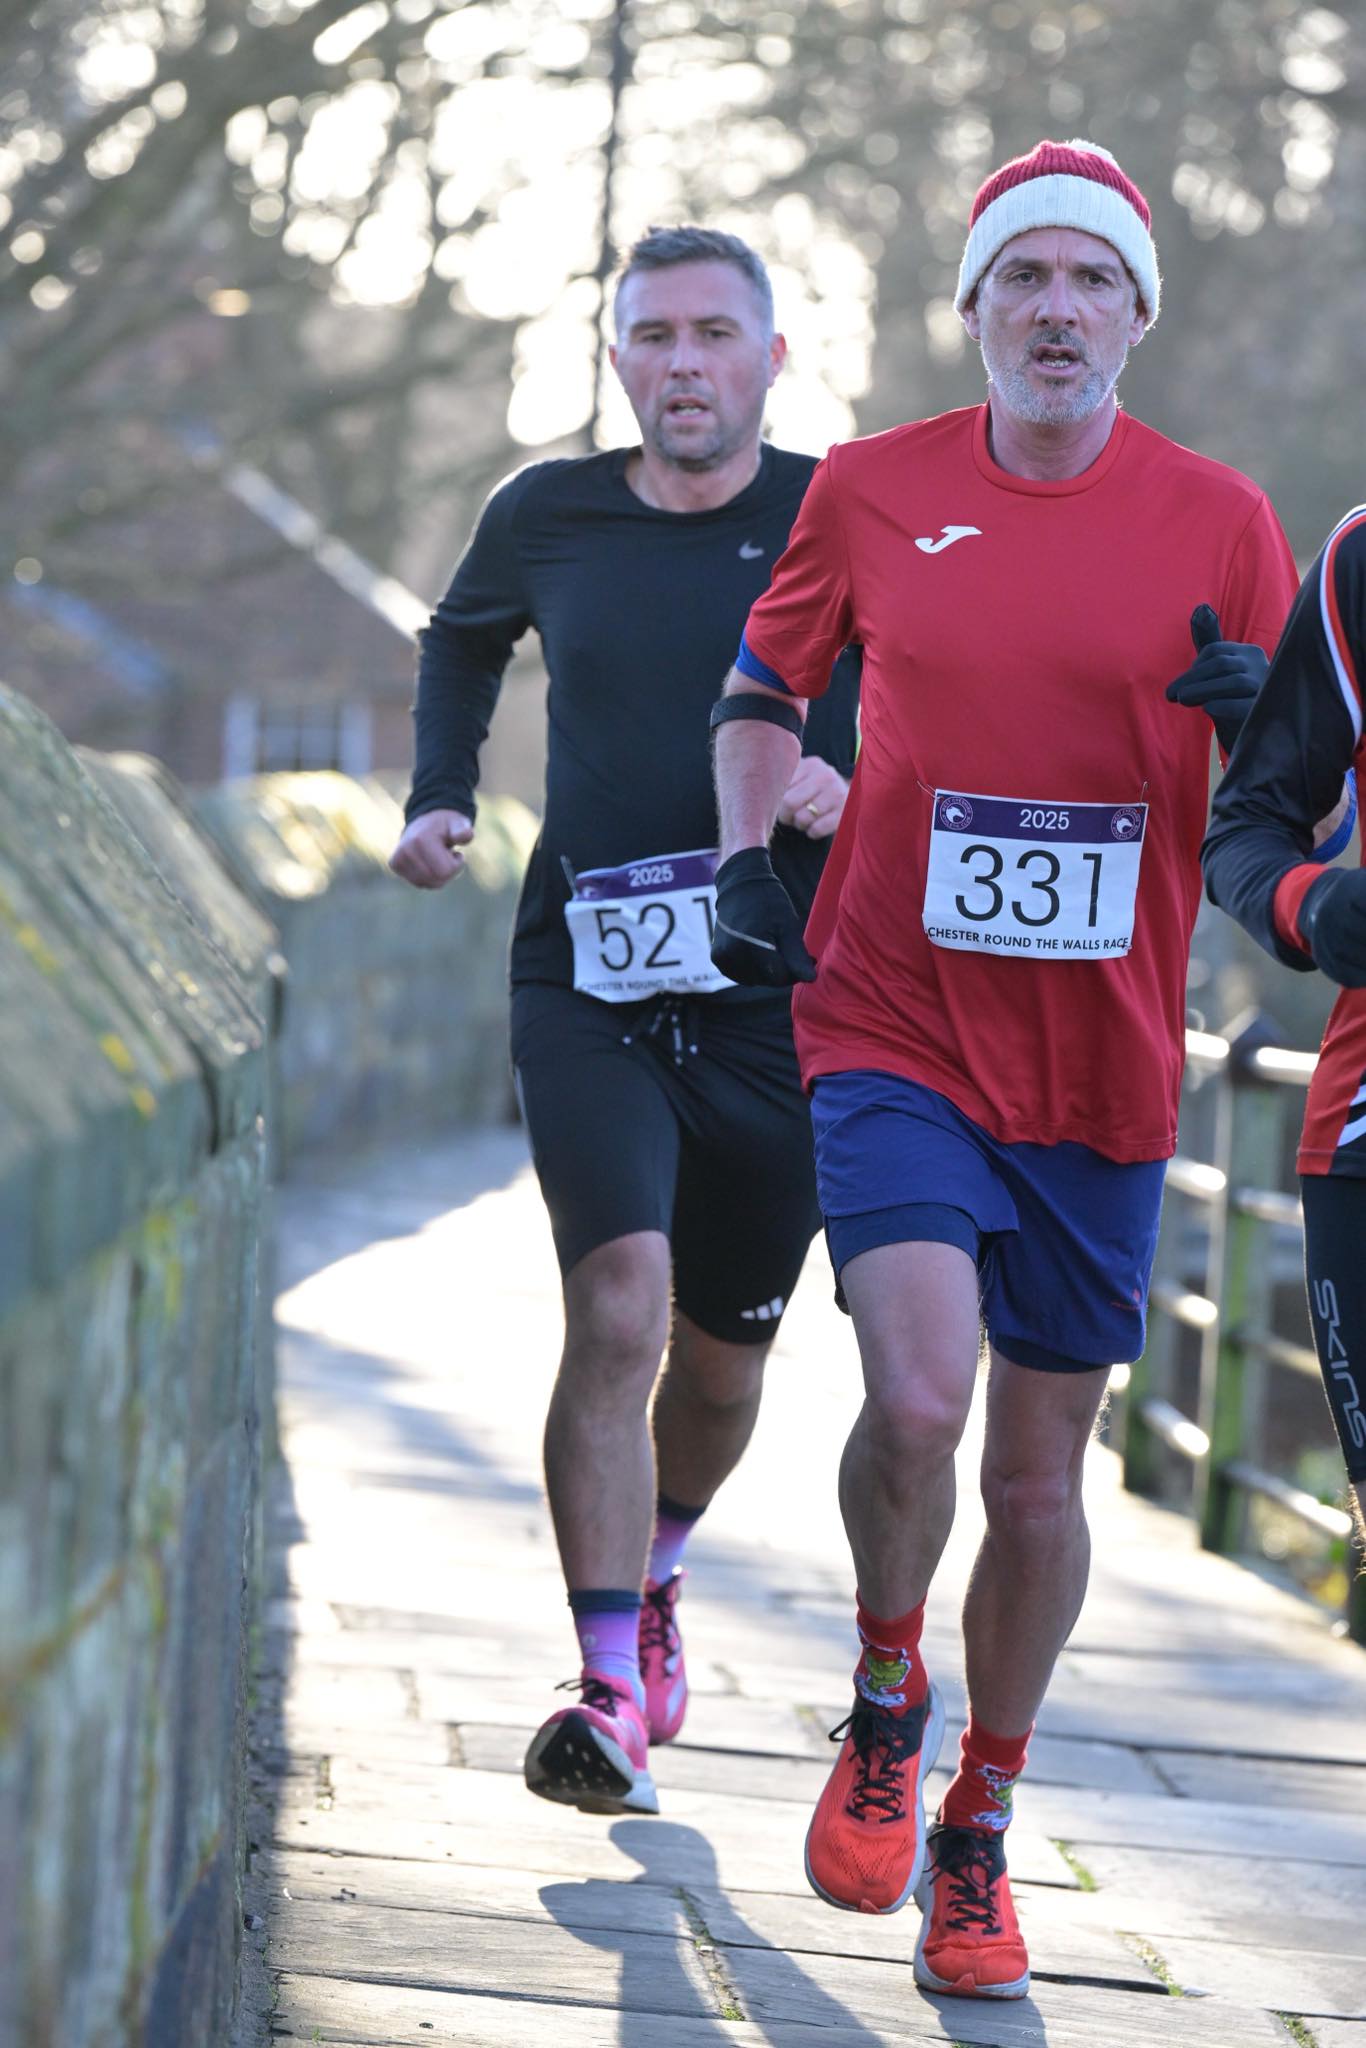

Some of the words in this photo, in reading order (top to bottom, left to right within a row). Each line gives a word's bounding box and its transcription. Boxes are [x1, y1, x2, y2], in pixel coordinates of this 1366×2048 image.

[1019, 808, 1070, 831] 2025
[628, 864, 674, 888] 2025
[955, 844, 1103, 928] 331
[594, 896, 715, 972] 521
[928, 926, 980, 943] CHESTER
[984, 934, 1032, 949] ROUND
[1036, 938, 1059, 950] THE
[1063, 939, 1101, 951] WALLS
[1103, 937, 1130, 951] RACE
